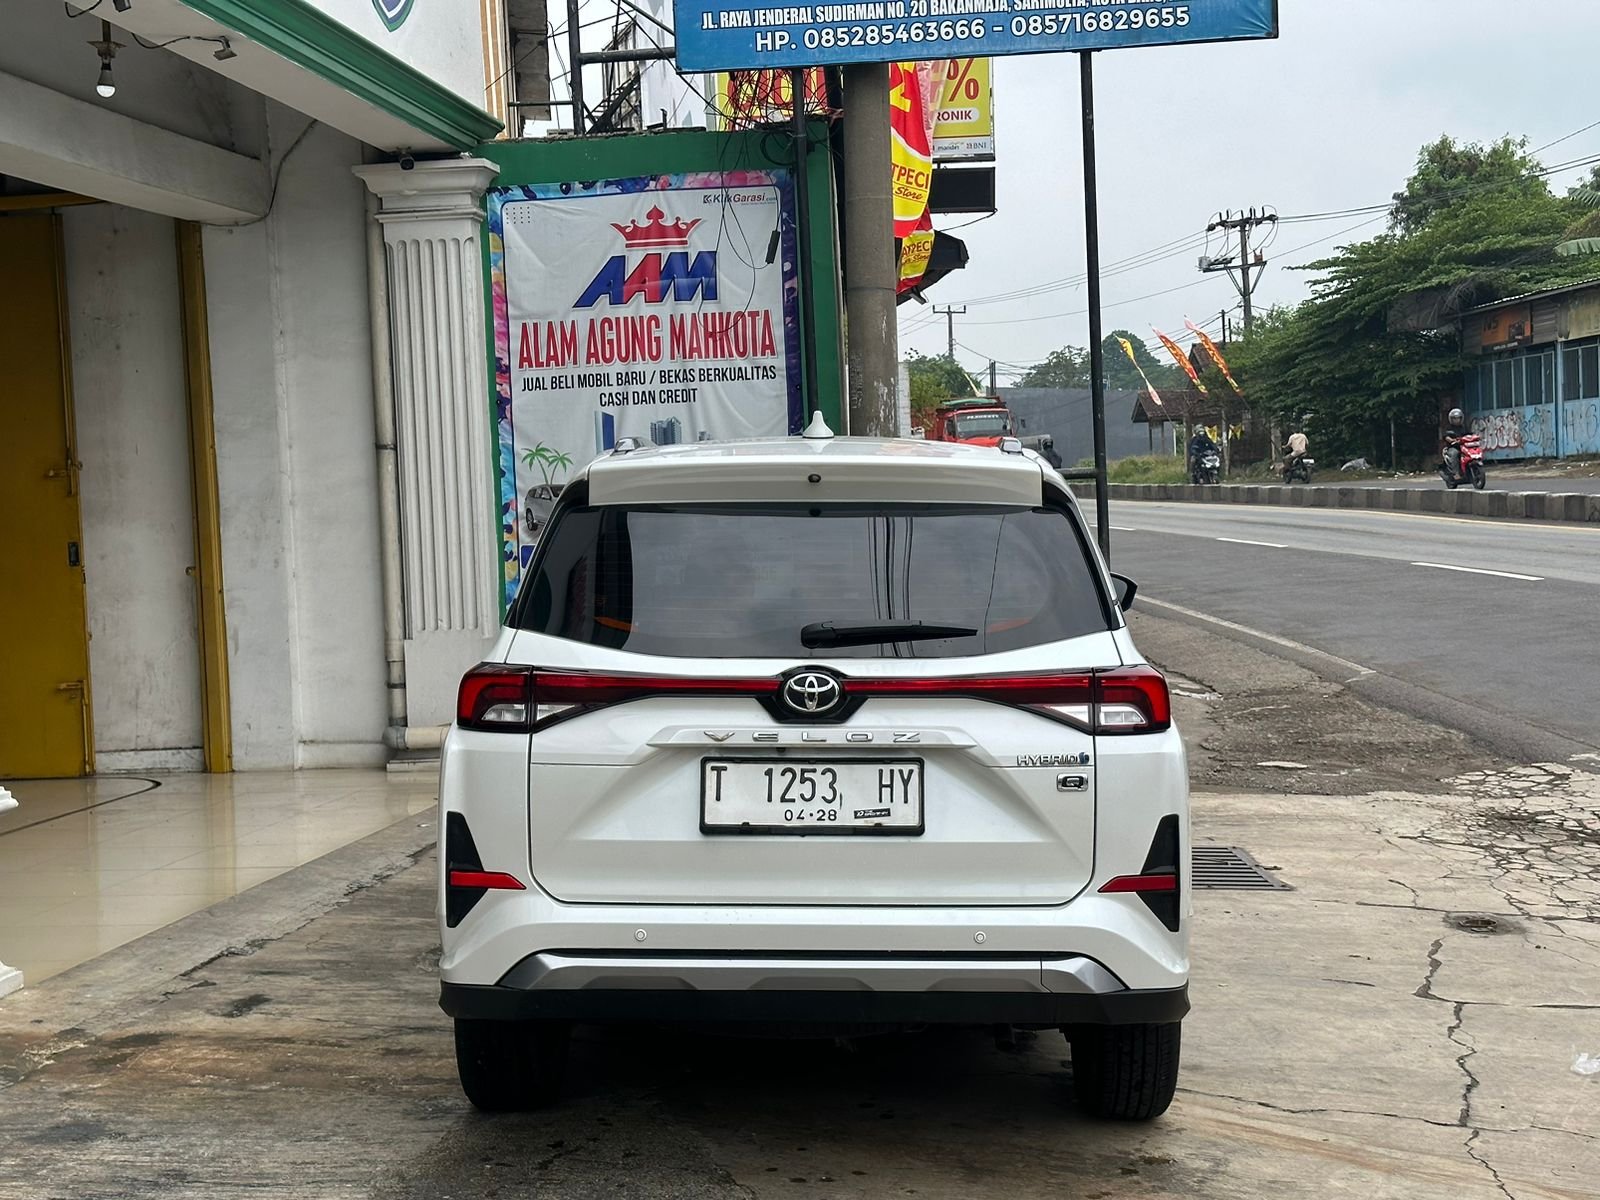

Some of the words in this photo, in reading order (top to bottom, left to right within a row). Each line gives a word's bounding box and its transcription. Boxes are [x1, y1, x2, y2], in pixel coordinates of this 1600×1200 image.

[702, 12, 718, 29] JL.
[720, 11, 751, 28] RAYA
[753, 7, 813, 26] JENDERAL
[816, 3, 884, 23] SUDIRMAN
[887, 1, 908, 19] NO.
[910, 0, 928, 17] 20
[930, 0, 1011, 16] BAKANMAJA,
[755, 30, 797, 52] HP.
[803, 18, 985, 49] 085285463666
[1011, 6, 1190, 36] 085716829655
[895, 186, 923, 200] Store
[572, 250, 718, 309] AAM
[518, 319, 579, 369] ALAM
[585, 314, 663, 365] AGUNG
[669, 308, 777, 361] MAHKOTA
[521, 376, 548, 392] JUAL
[550, 374, 575, 390] BELI
[577, 372, 613, 389] MOBIL
[616, 370, 646, 386] BARU
[649, 369, 657, 385] /
[659, 367, 696, 384] BEKAS
[698, 365, 777, 382] BERKUALITAS
[599, 391, 629, 408] CASH
[632, 389, 656, 405] DAN
[658, 387, 698, 404] CREDIT
[703, 730, 921, 743] VELOZ
[1016, 754, 1080, 766] HYBRID
[710, 766, 728, 802] T
[764, 767, 838, 804] 1253
[878, 768, 914, 804] HY
